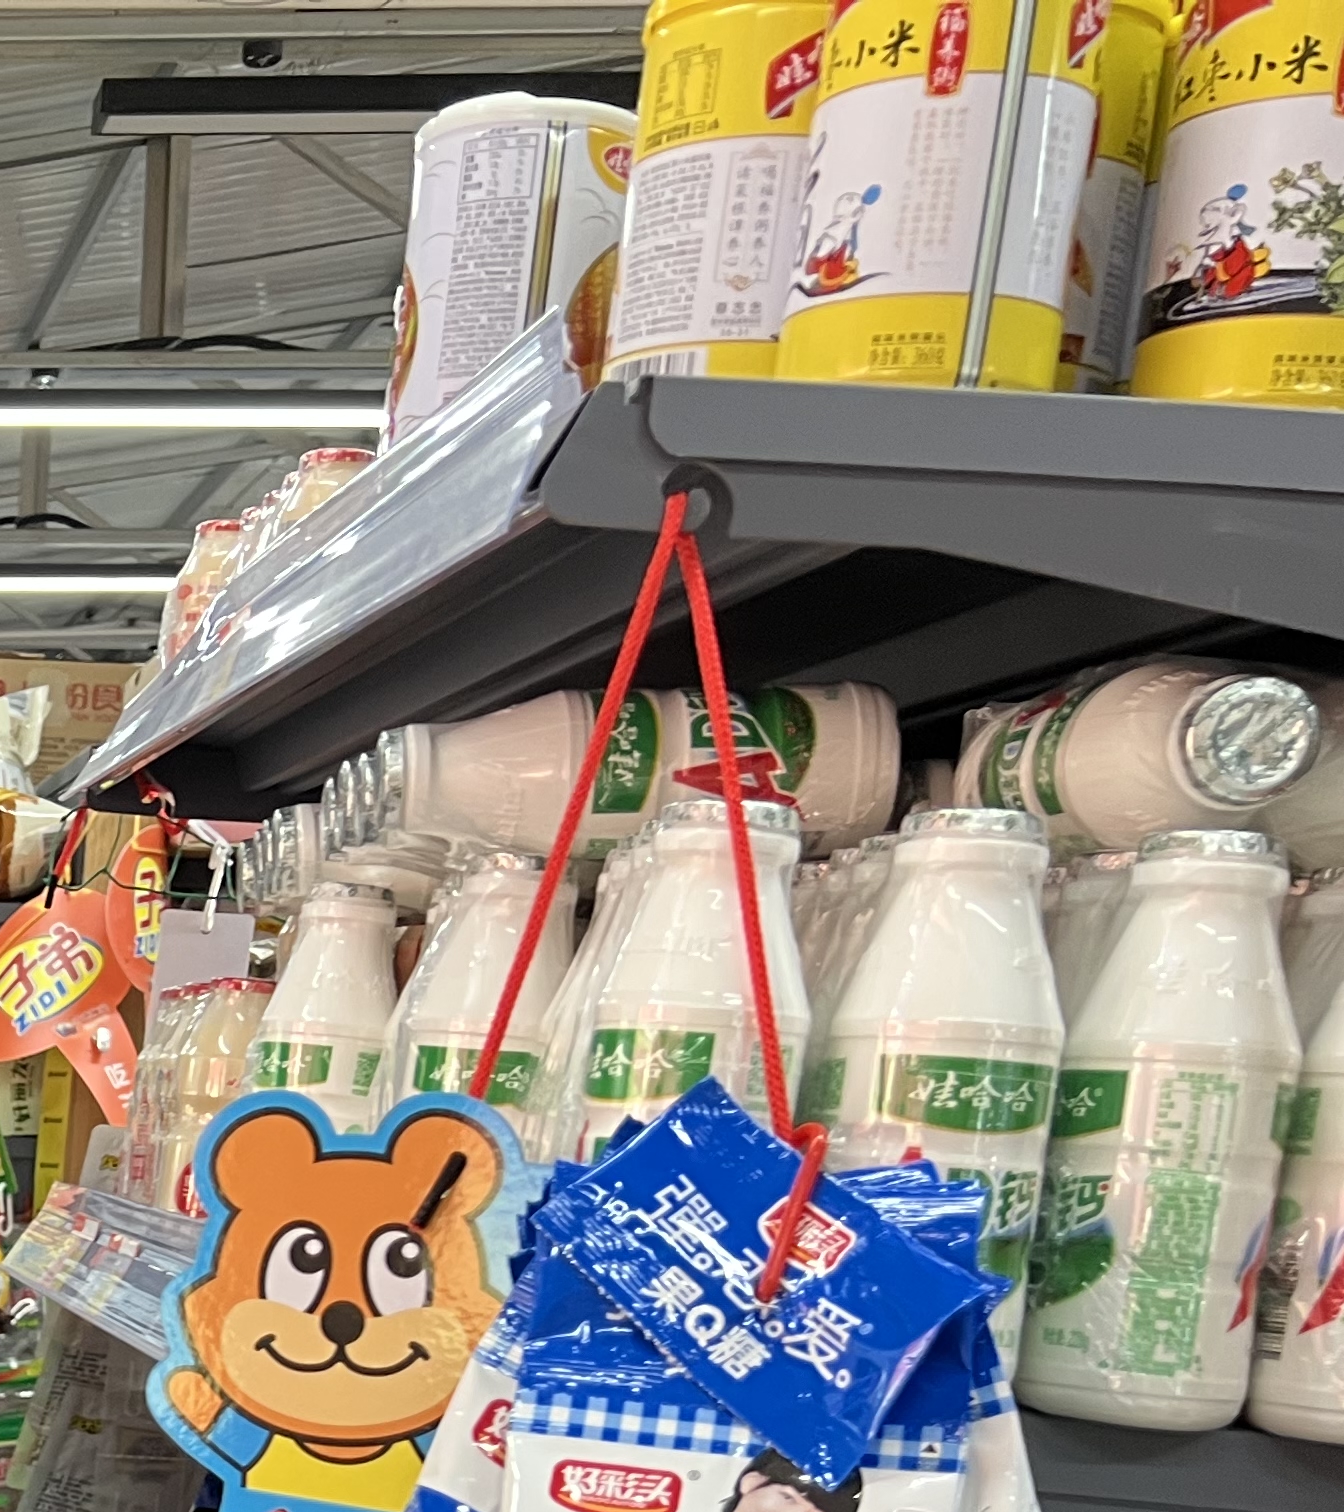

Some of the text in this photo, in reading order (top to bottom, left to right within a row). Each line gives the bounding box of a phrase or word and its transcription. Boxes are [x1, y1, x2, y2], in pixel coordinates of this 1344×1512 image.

[12, 979, 69, 1036] ZIDI
[908, 1070, 1036, 1111] 娃哈哈
[640, 1264, 772, 1381] 果Q糖
[561, 1464, 675, 1508] 好彩头
